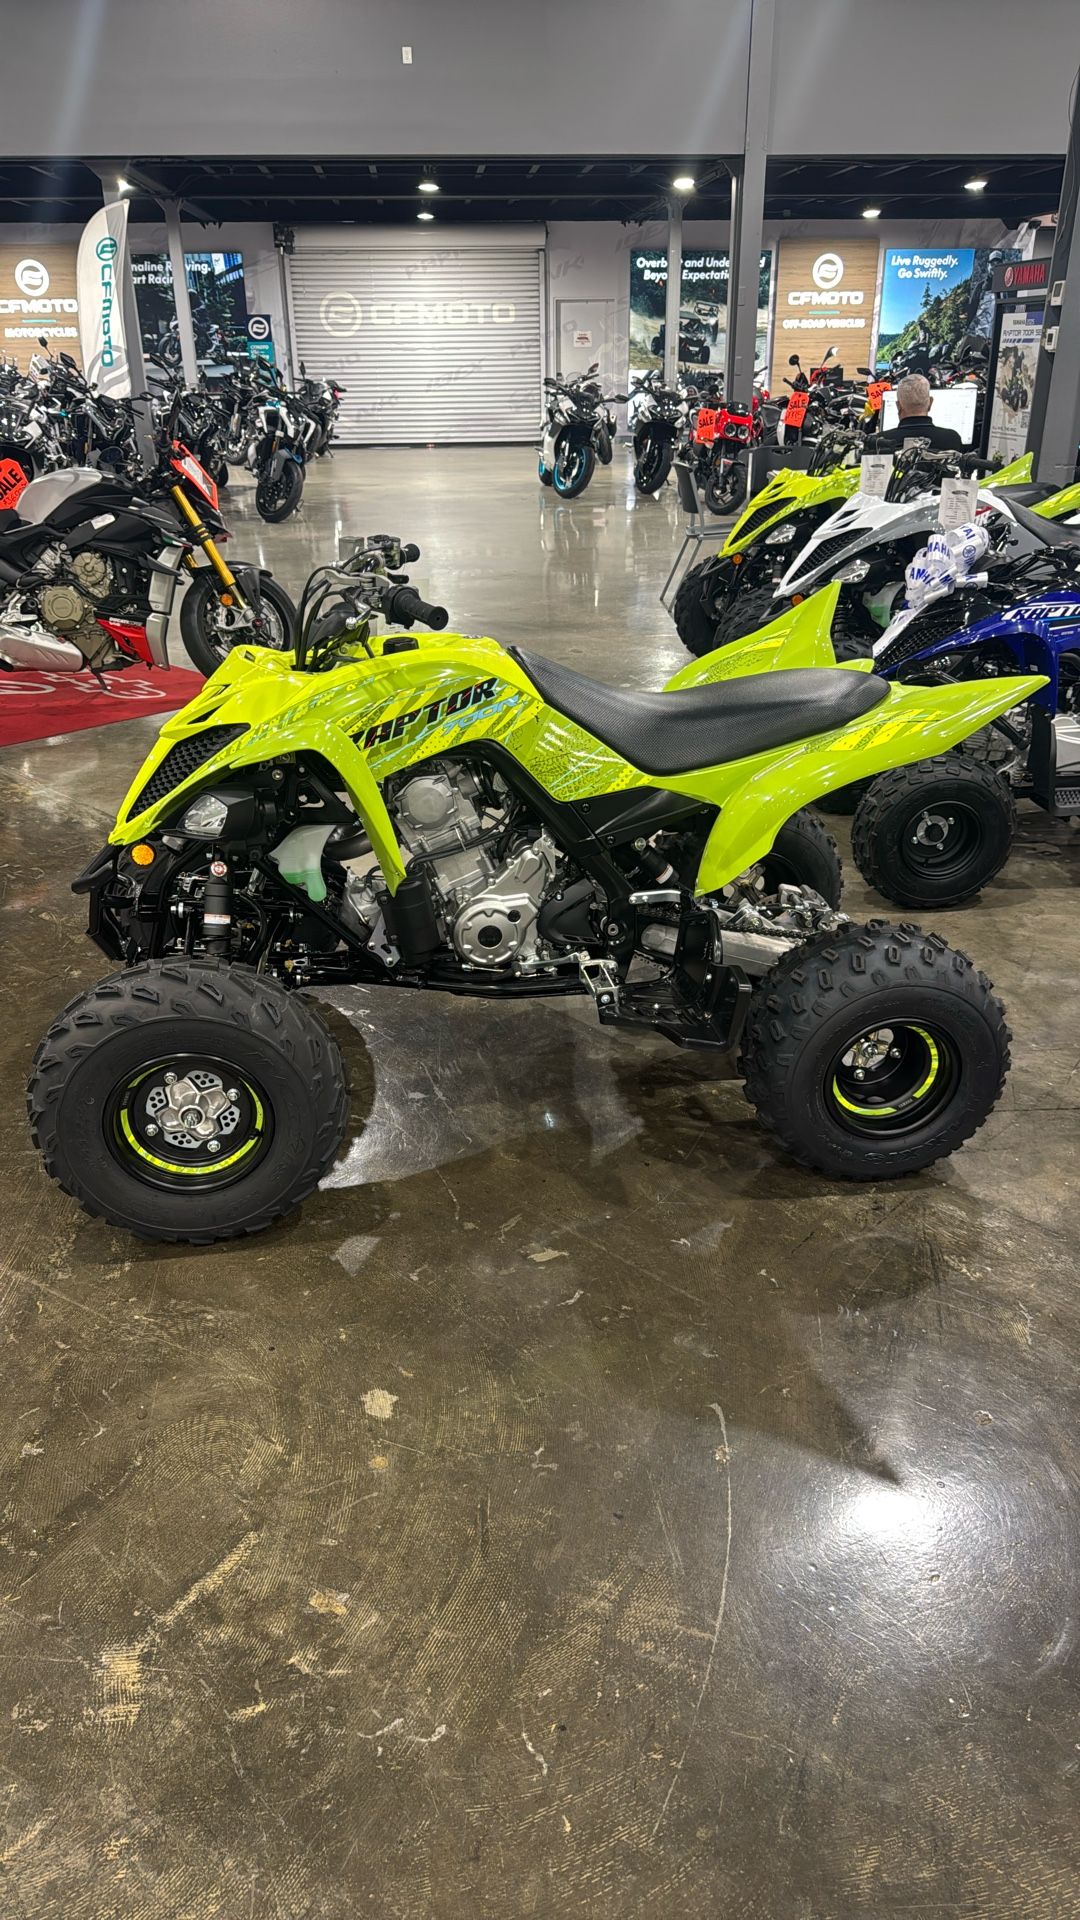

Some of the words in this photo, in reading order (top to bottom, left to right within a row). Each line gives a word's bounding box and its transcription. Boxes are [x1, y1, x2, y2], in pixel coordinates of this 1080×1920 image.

[131, 261, 164, 272] naline
[165, 261, 211, 275] Rving.
[684, 258, 705, 268] and
[891, 255, 911, 266] Live
[912, 255, 958, 268] Ruggedly.
[898, 268, 912, 278] Go
[913, 267, 948, 280] Swiftly.
[1013, 263, 1046, 286] YAMAHA
[788, 291, 864, 305] CFMOTO
[0, 298, 78, 313] CFMOTO
[101, 263, 114, 368] CFMOTO
[369, 303, 516, 325] CFMOTO
[826, 318, 866, 329] VEHICLES
[4, 327, 78, 338] MOTORCYCLES
[790, 399, 806, 410] SALE
[698, 416, 714, 428] SALE
[441, 694, 520, 736] 700R
